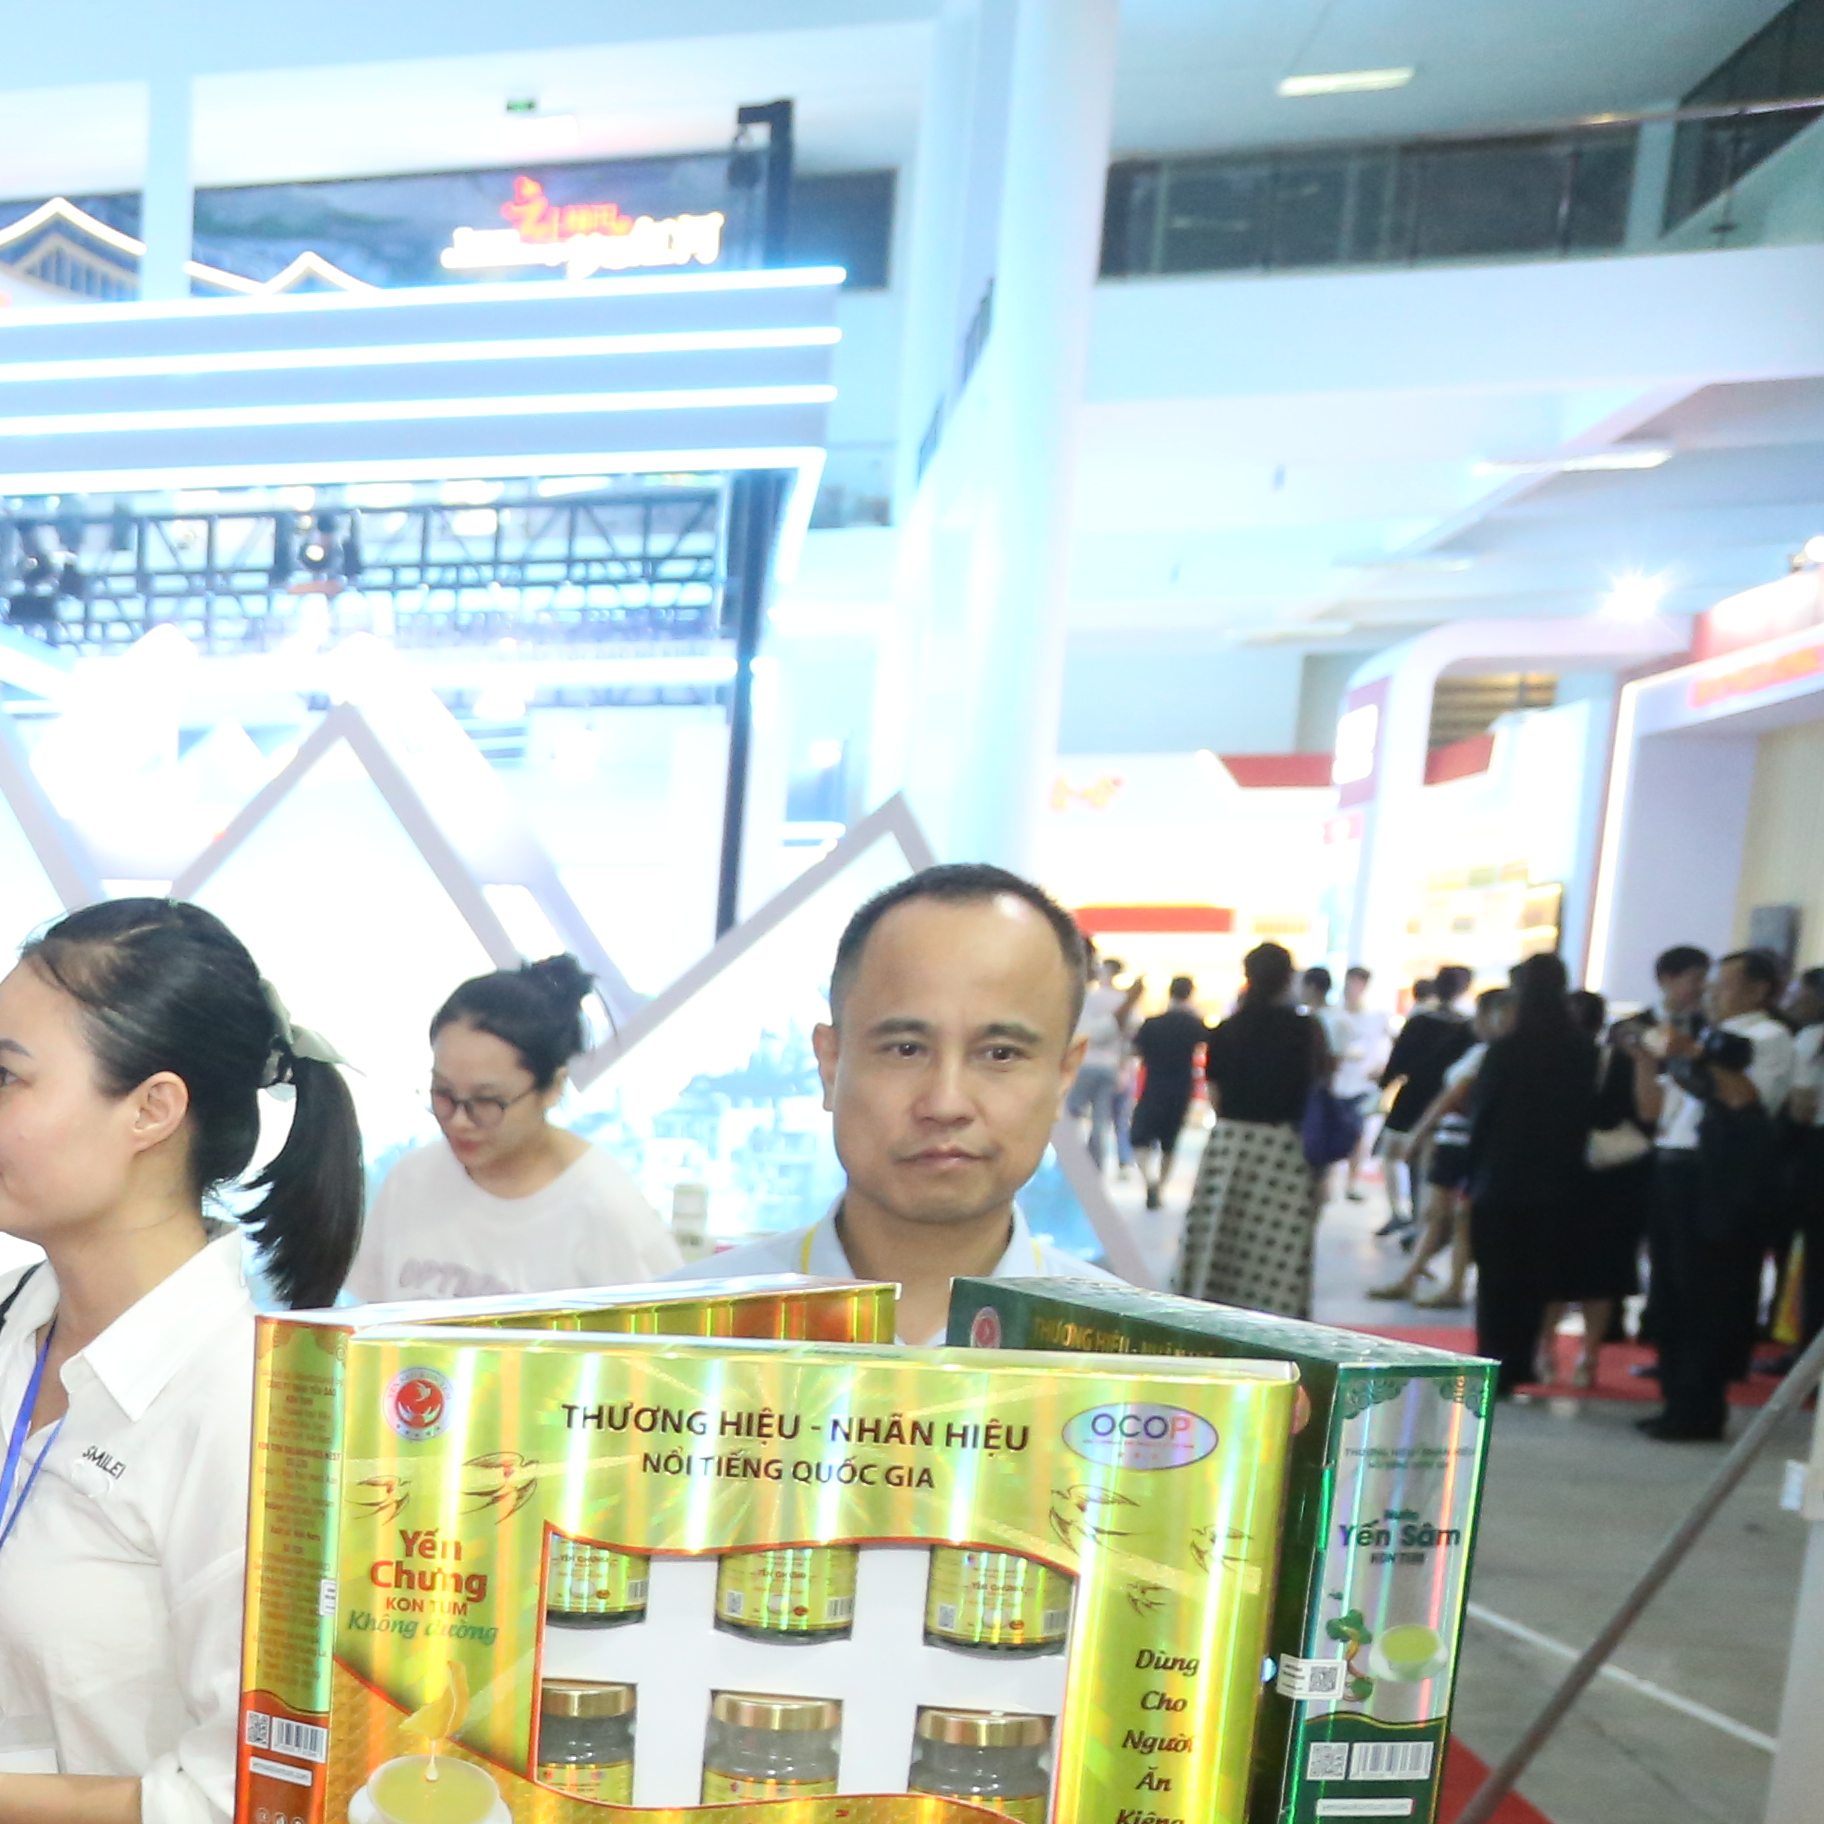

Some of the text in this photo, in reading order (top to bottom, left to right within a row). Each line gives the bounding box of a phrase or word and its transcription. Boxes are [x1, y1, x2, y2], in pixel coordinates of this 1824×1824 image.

[561, 1402, 708, 1437] THƯƠNG
[718, 1407, 801, 1445] HIỆU
[829, 1413, 935, 1447] NHÃN
[944, 1419, 1030, 1457] HIỆU
[1090, 1413, 1193, 1441] OCOP
[642, 1445, 935, 1489] NỔI TIẾNG QUỐC GIA
[399, 1528, 462, 1560] Yến
[1339, 1519, 1461, 1546] Yến Sâm
[370, 1560, 487, 1602] Chưng
[386, 1597, 468, 1616] KON TUM
[348, 1611, 419, 1640] Không
[1135, 1648, 1200, 1676] Dùng
[1140, 1690, 1188, 1713] Cho
[1122, 1729, 1193, 1755] Người
[1136, 1766, 1172, 1793] Ăn
